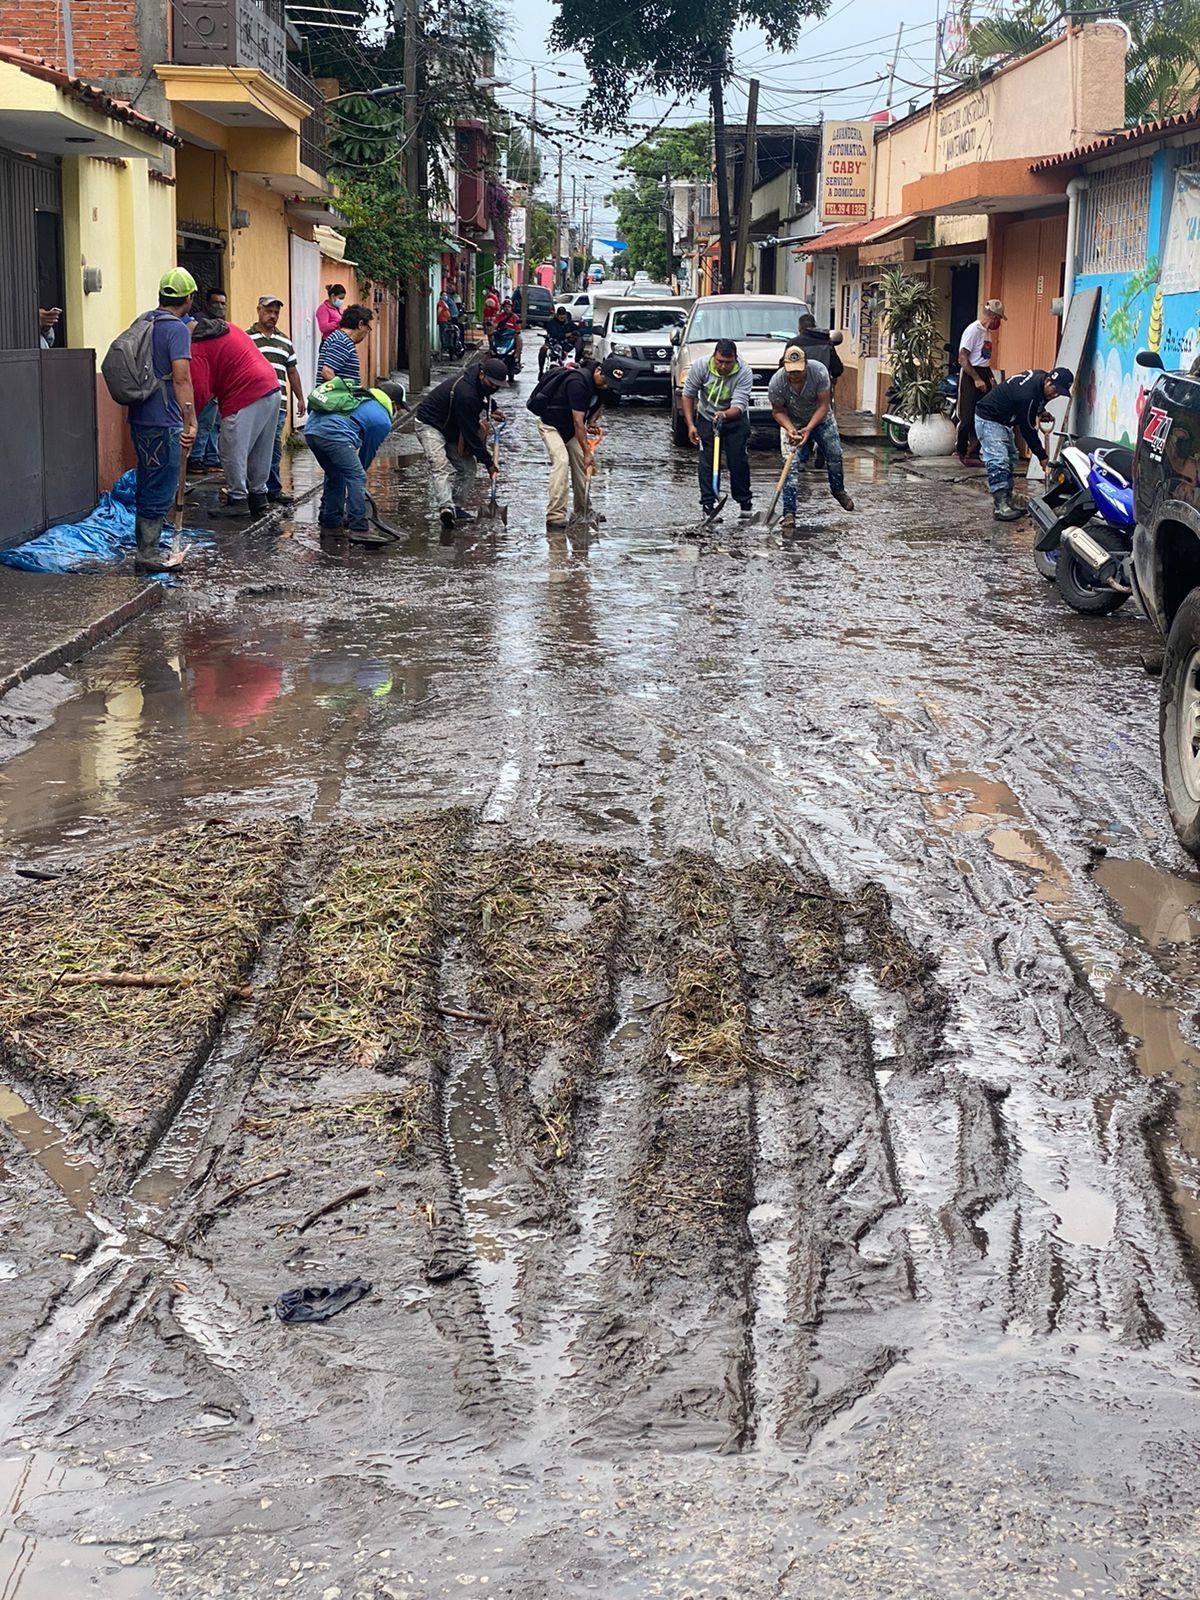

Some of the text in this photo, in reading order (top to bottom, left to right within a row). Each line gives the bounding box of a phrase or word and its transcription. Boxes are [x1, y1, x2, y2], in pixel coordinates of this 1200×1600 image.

[826, 177, 853, 186] SERVICIO
[828, 188, 866, 197] A DOMICILIO
[1143, 406, 1173, 442] Z71
